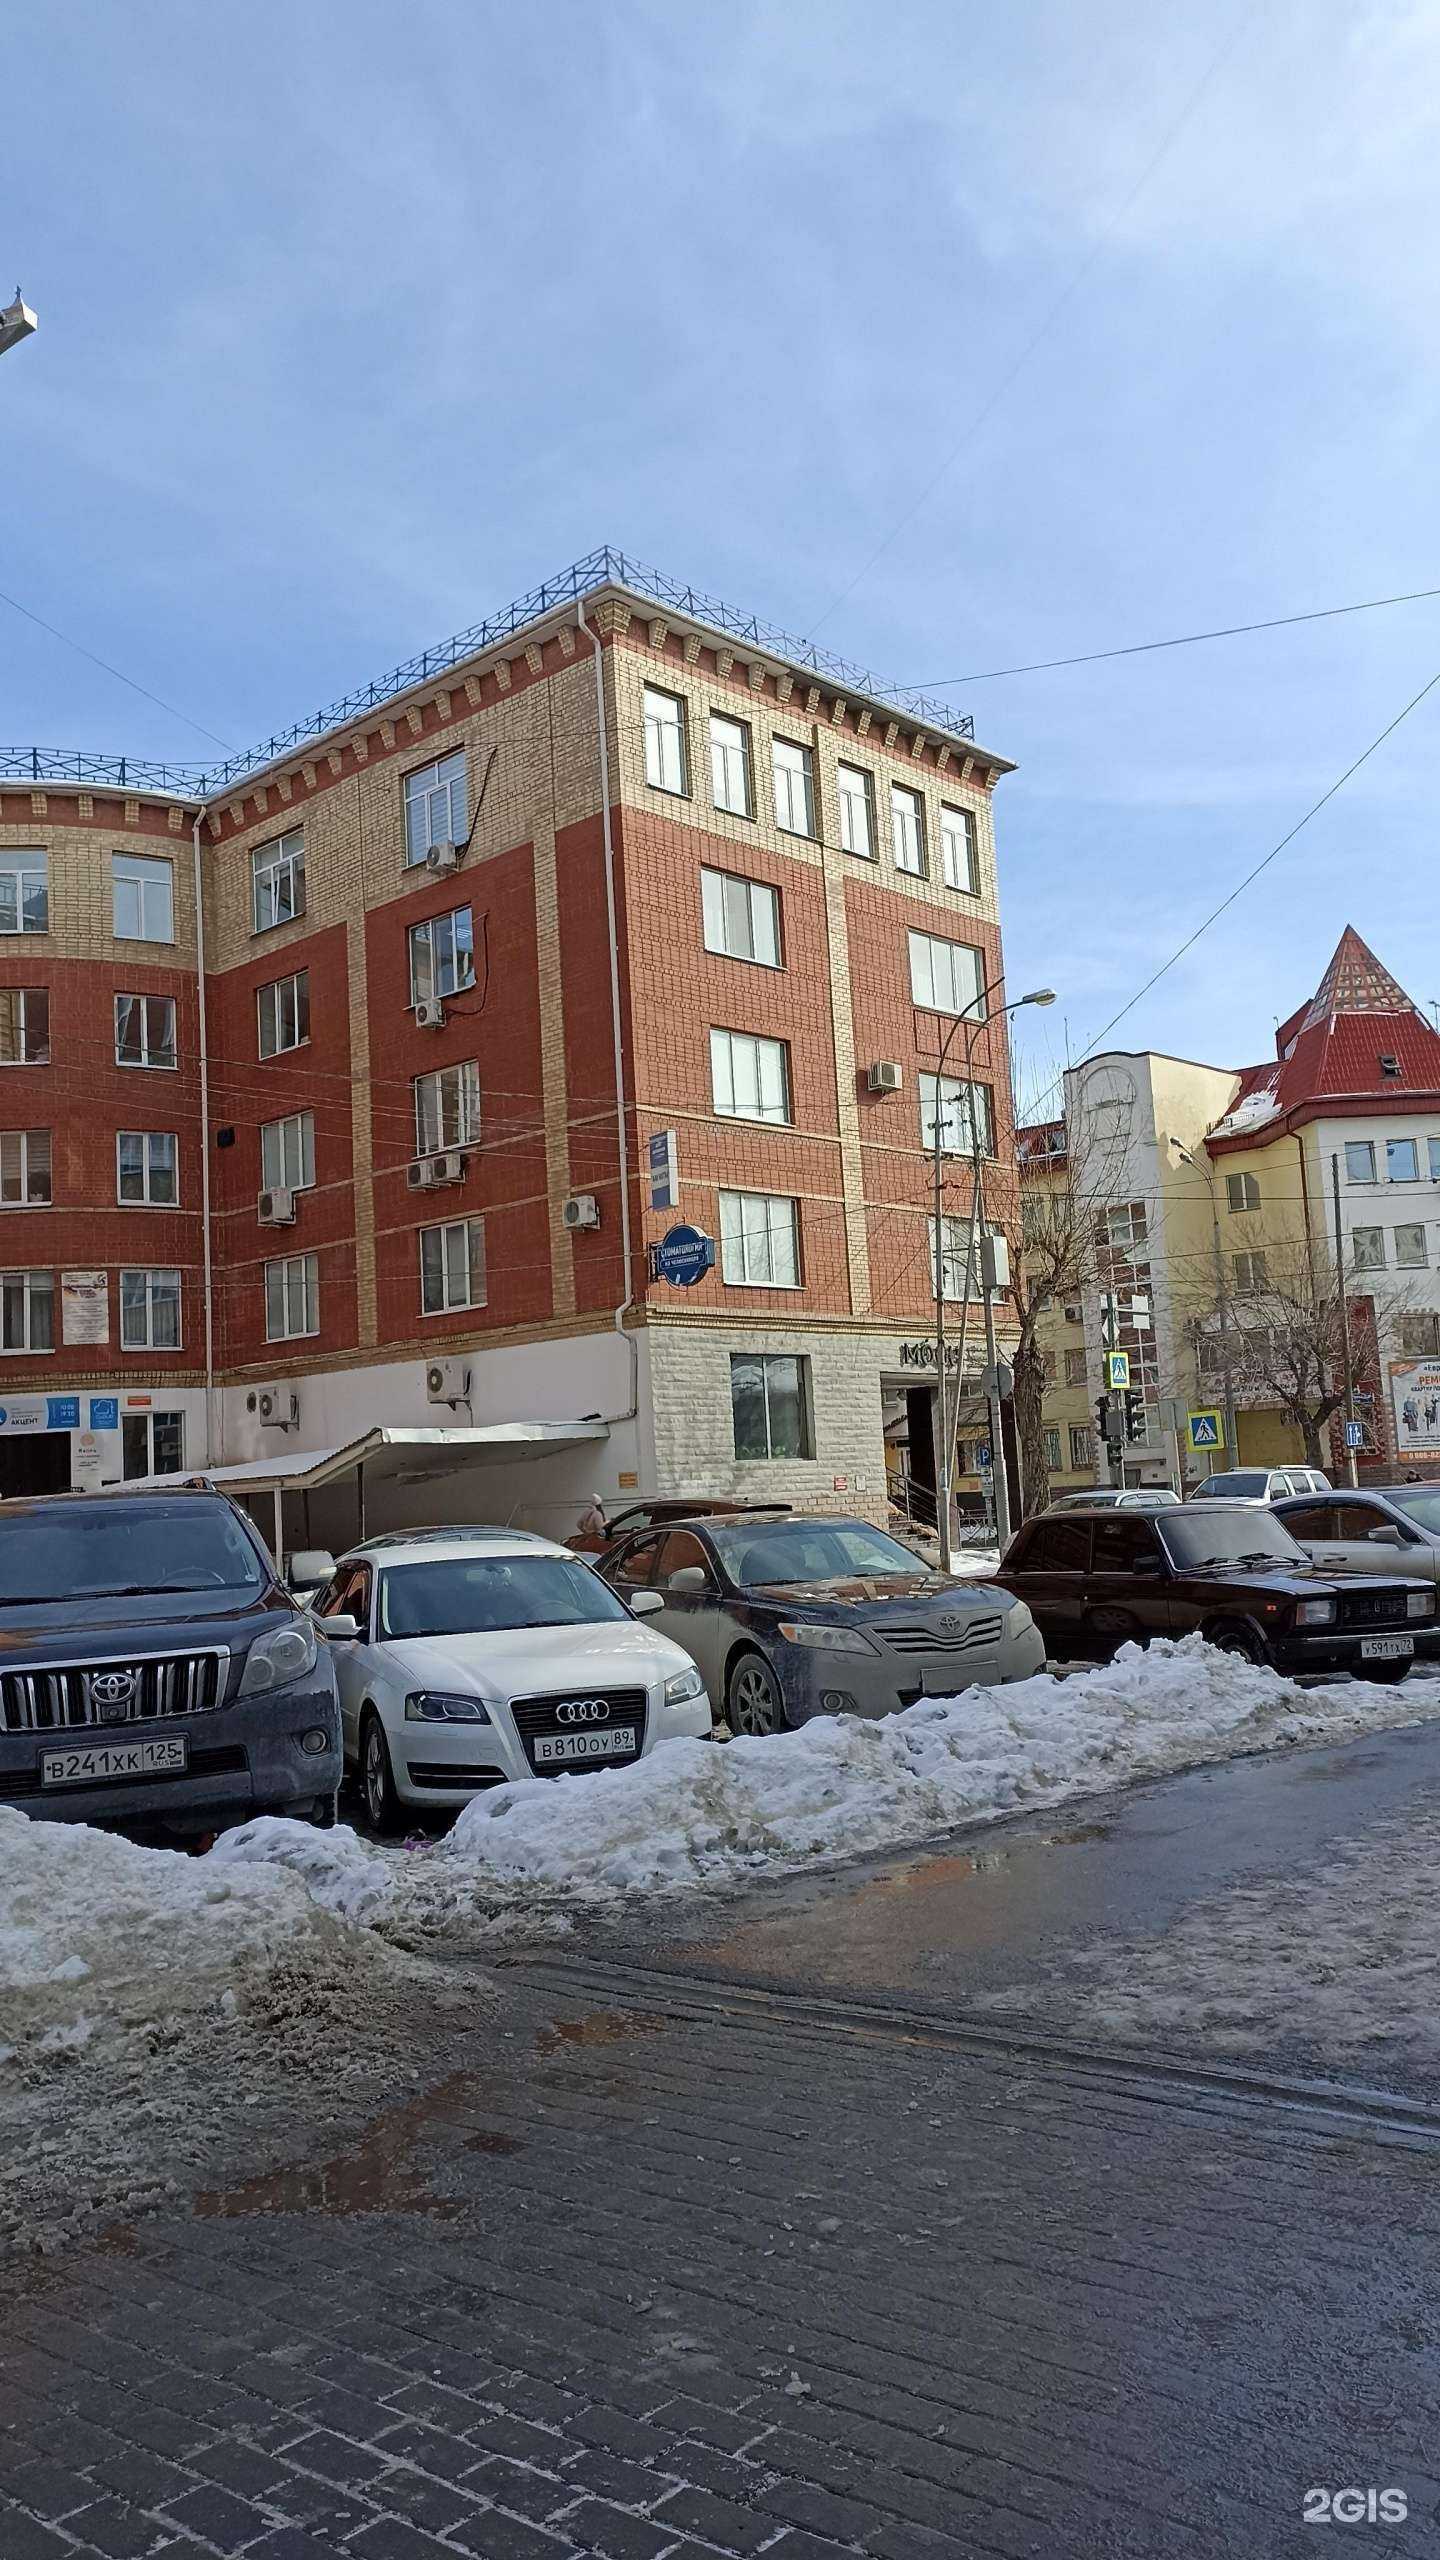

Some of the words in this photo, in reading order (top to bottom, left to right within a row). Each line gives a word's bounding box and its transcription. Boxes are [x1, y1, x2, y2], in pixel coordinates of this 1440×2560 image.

[11, 1418, 38, 1426] АКЦЕНТ
[1402, 1640, 1411, 1649] 72
[614, 1731, 630, 1745] 89
[146, 1743, 177, 1761] 125
